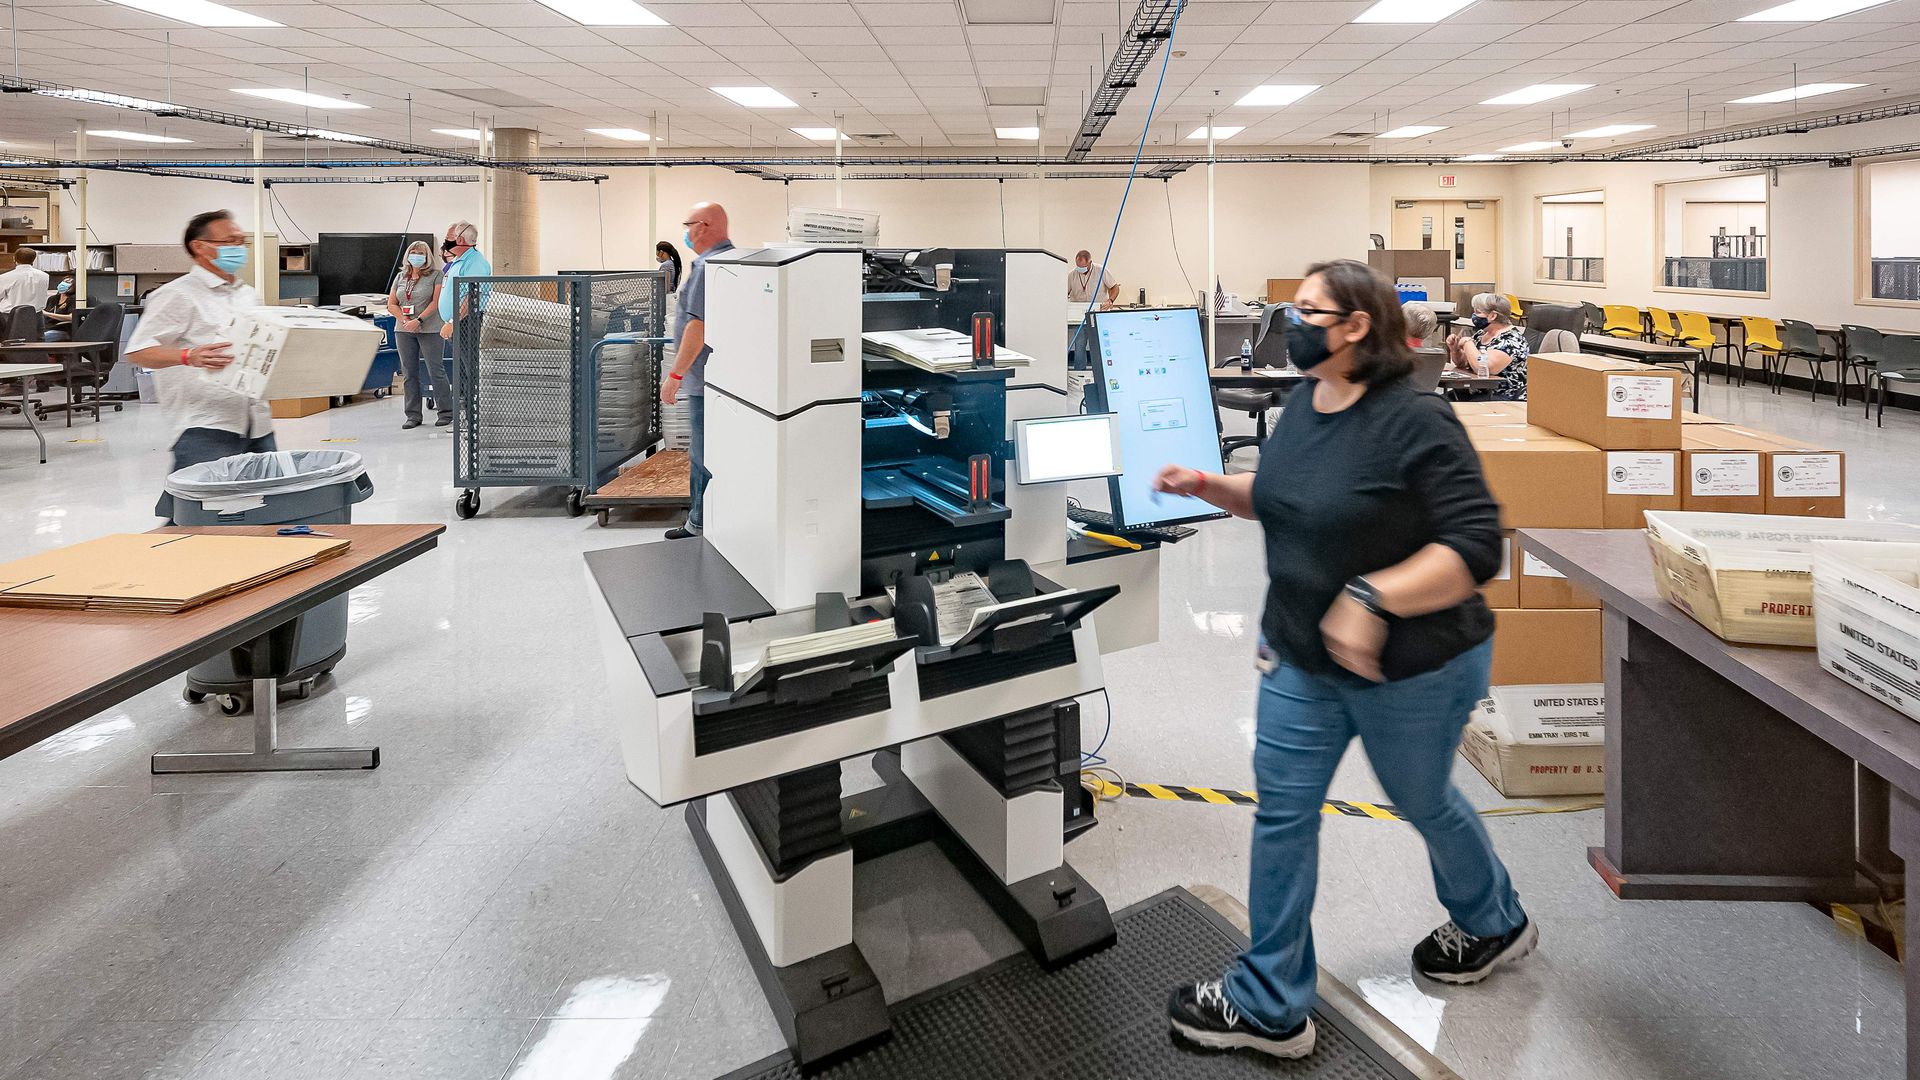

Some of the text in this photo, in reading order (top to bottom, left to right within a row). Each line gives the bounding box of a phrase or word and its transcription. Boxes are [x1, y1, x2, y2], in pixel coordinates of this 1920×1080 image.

[1442, 176, 1455, 186] EXIT
[1761, 602, 1813, 617] PROPERT
[1839, 622, 1919, 671] UNITED STATES
[1533, 698, 1566, 708] UNITED
[1567, 697, 1599, 707] STATES
[1529, 764, 1569, 775] PROPERTY
[1572, 764, 1582, 775] OF
